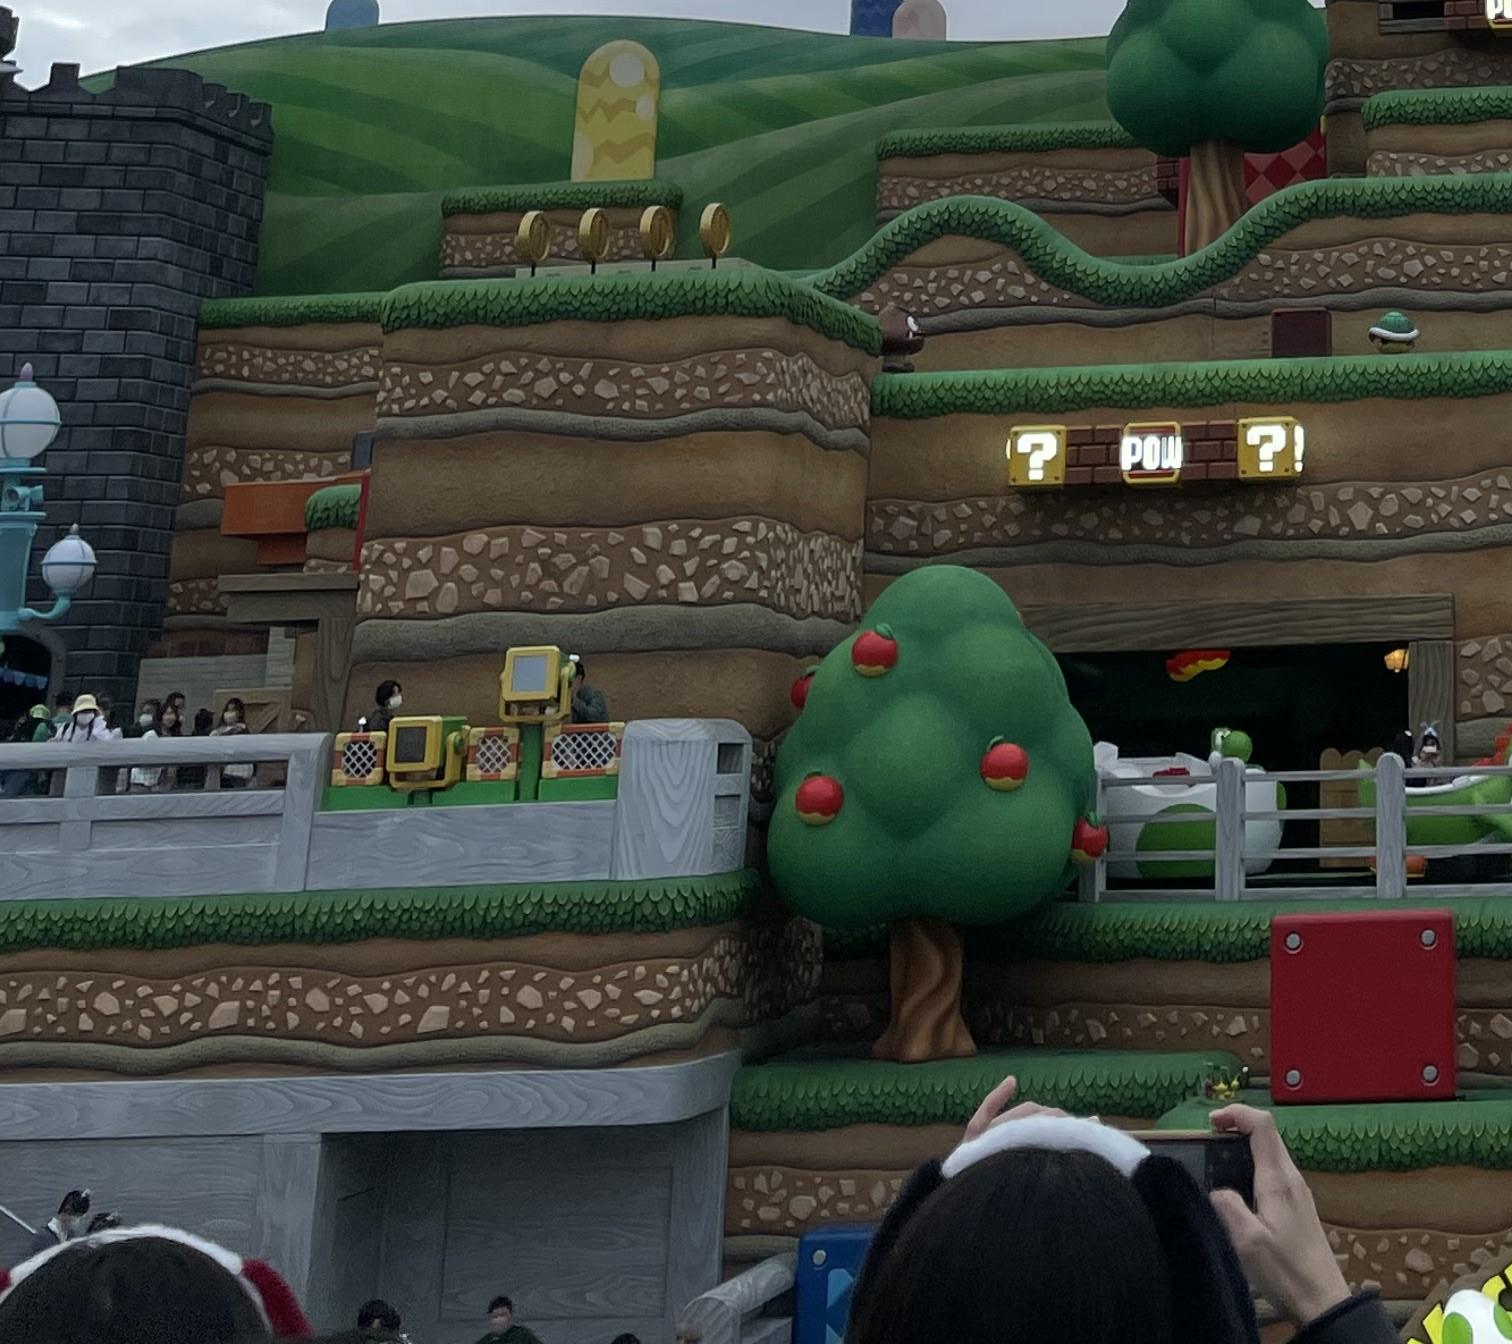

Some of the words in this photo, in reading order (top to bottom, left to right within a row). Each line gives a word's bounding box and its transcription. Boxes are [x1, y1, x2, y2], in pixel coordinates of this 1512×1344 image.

[1017, 432, 1057, 481] ?
[1121, 435, 1183, 471] POW
[1247, 425, 1286, 472] ?
